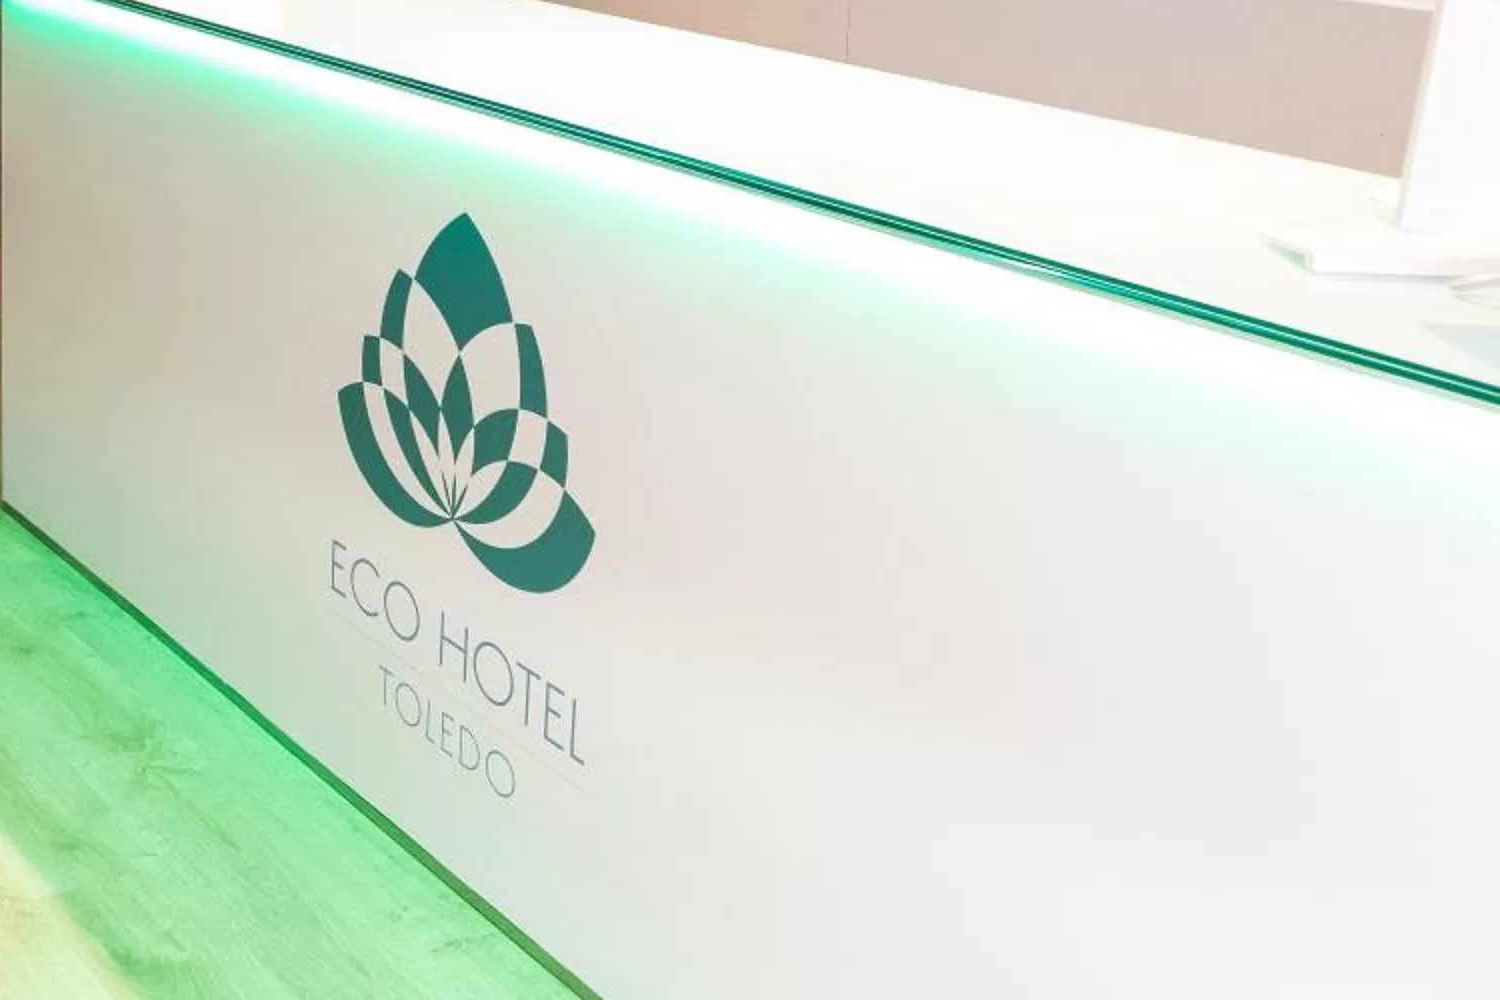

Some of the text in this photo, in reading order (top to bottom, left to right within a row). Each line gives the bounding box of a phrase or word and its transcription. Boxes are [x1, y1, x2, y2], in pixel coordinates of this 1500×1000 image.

[330, 539, 585, 766] ECO HOTEL
[378, 664, 516, 798] TOLEDO
